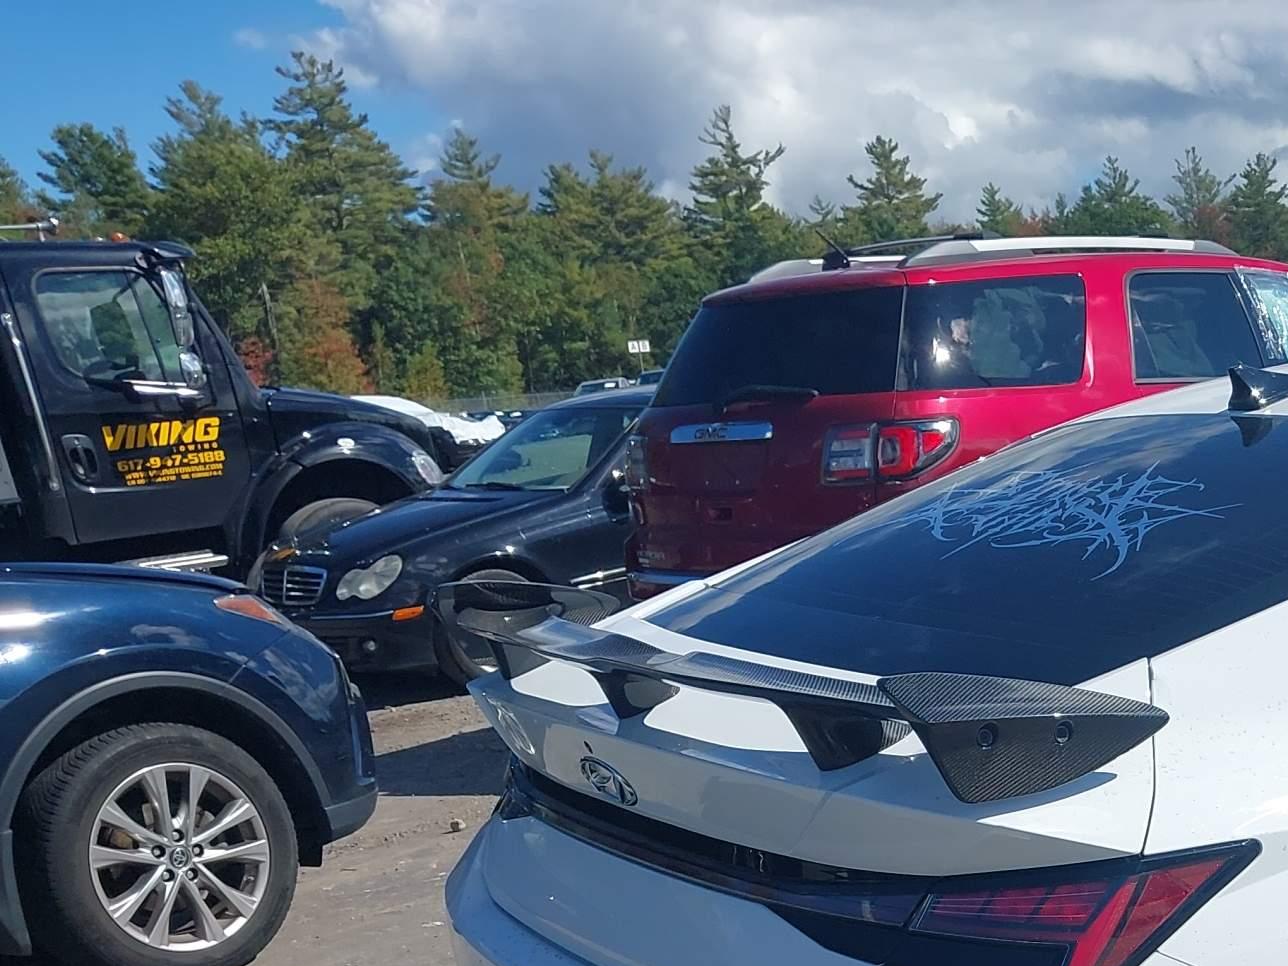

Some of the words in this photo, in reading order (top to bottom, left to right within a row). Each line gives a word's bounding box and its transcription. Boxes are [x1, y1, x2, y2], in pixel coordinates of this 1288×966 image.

[102, 417, 220, 450] VIKING
[694, 427, 728, 440] GMC
[172, 442, 218, 453] TOWING
[117, 450, 225, 471] 617-947-5188
